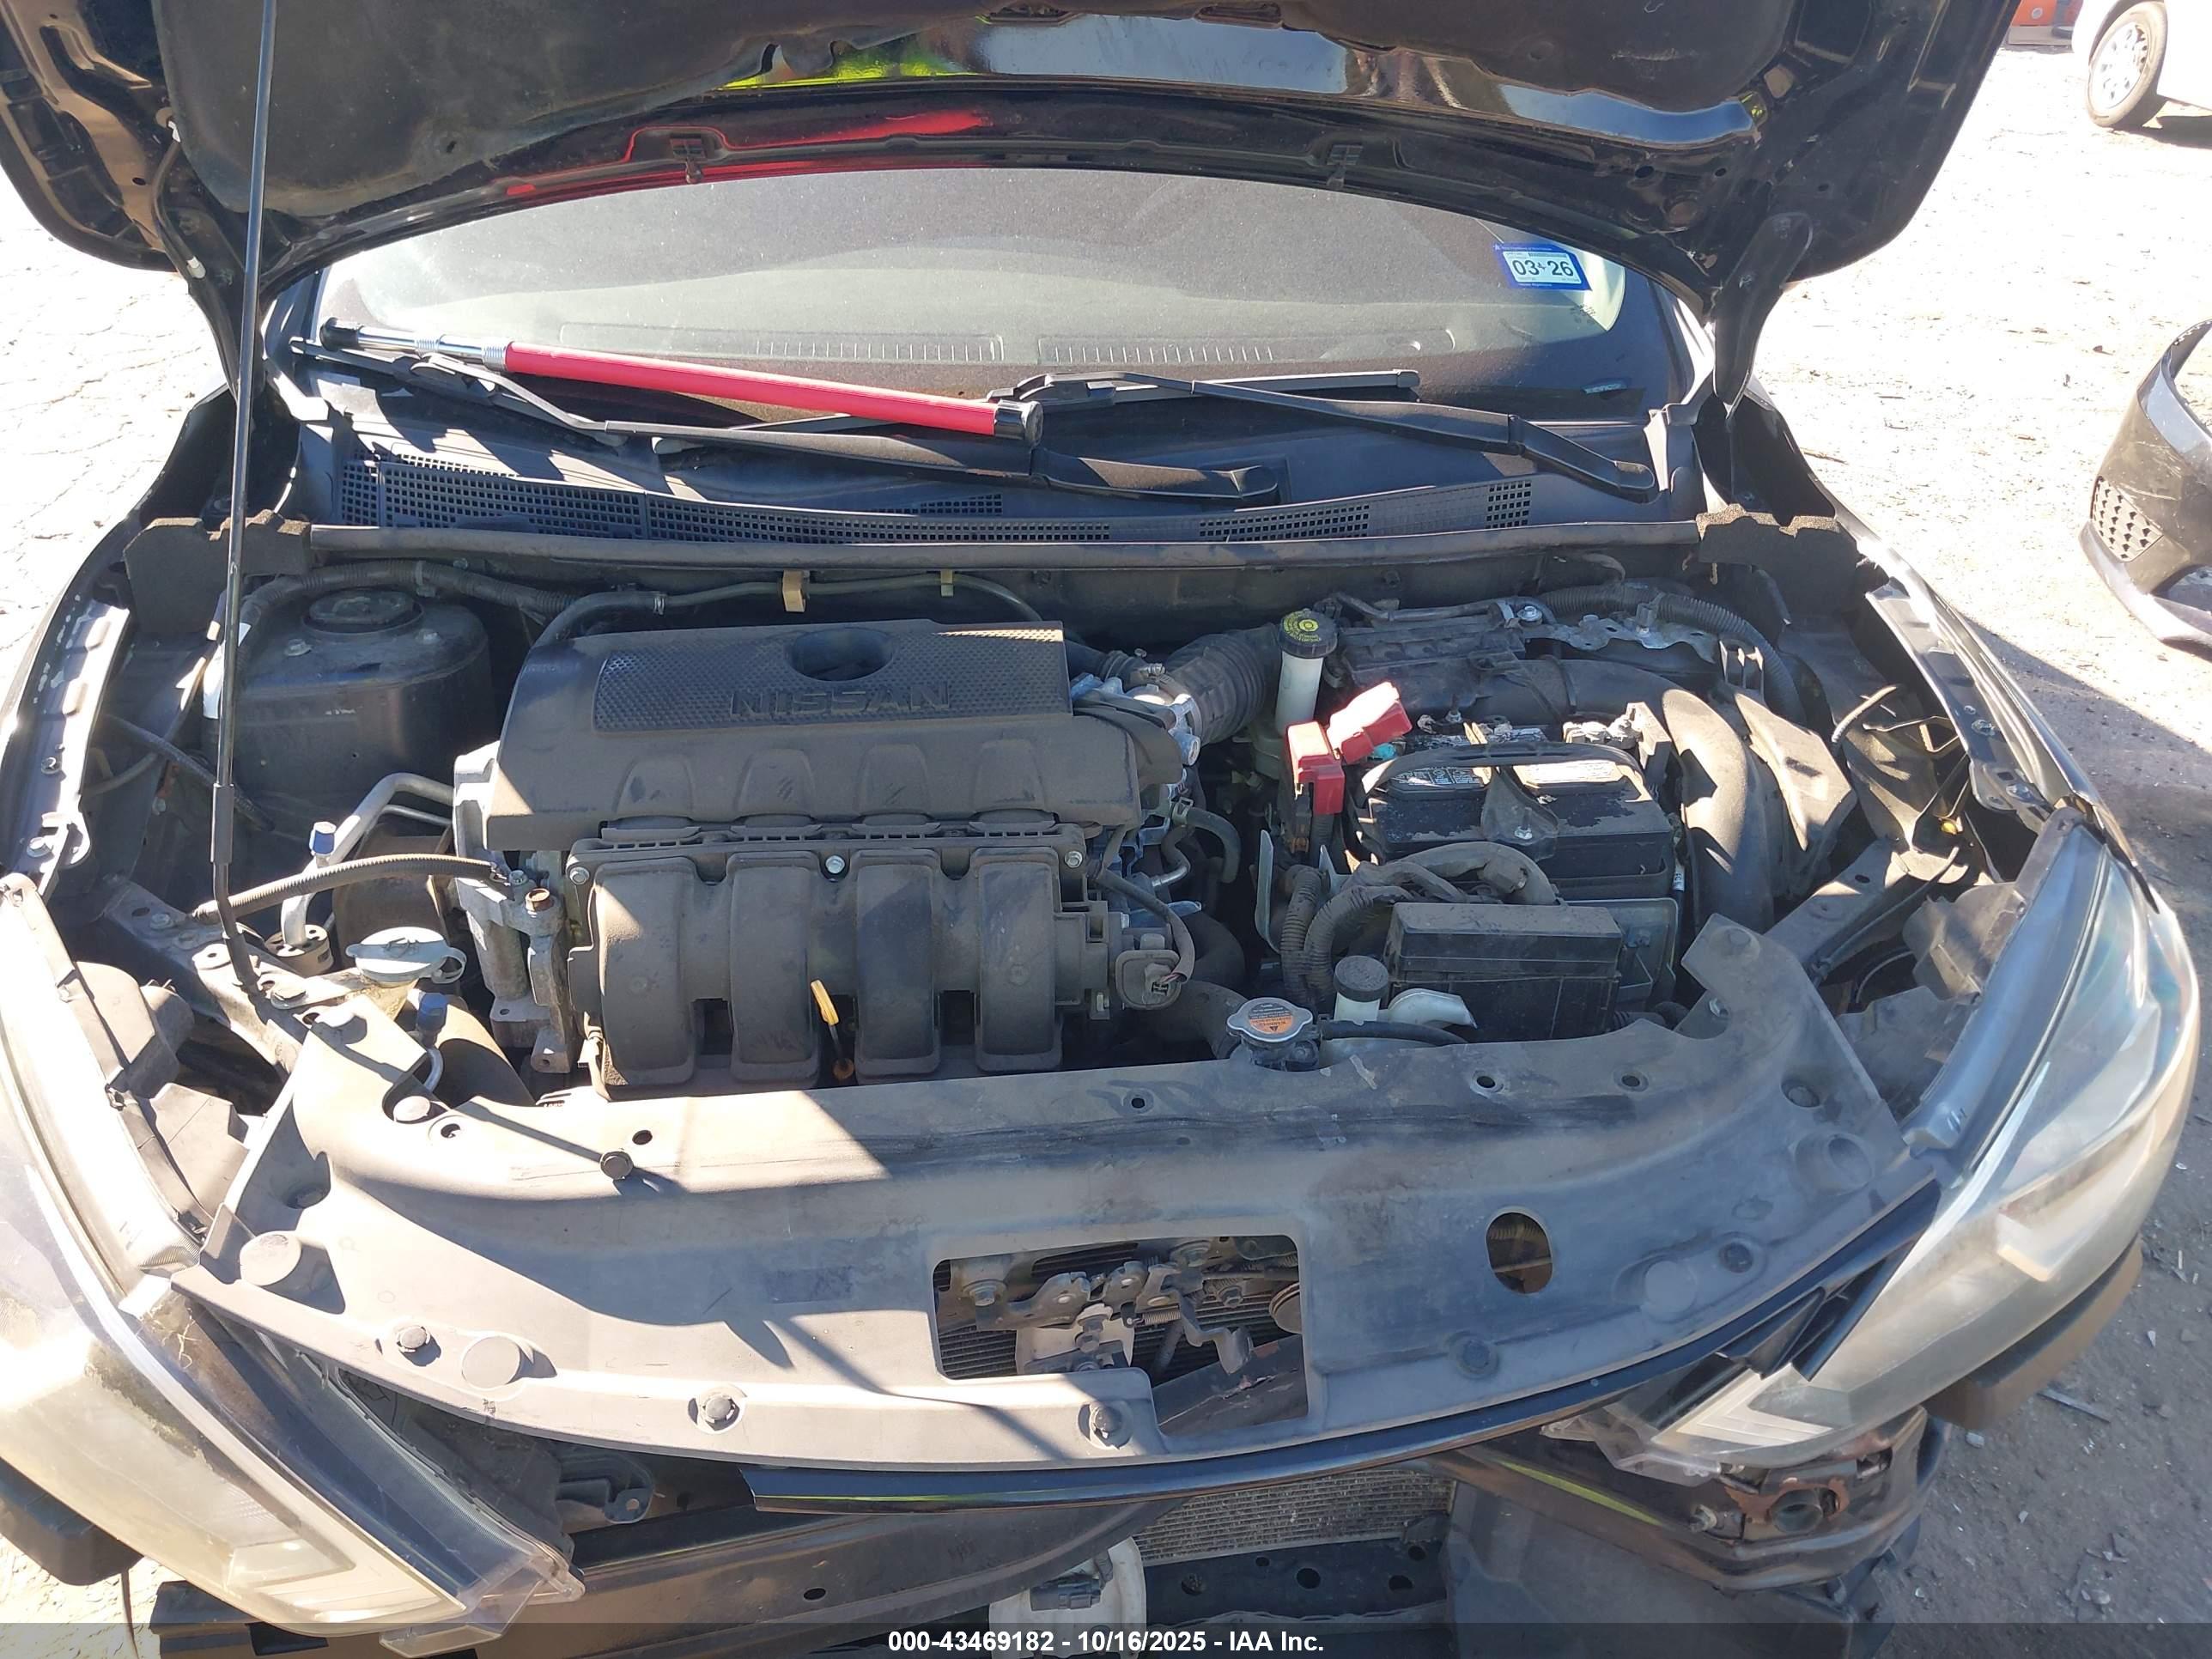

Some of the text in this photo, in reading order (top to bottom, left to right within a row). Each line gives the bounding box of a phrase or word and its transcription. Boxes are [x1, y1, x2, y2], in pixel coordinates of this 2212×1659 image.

[1512, 259, 1574, 276] 03 26
[730, 686, 951, 717] NISSAN
